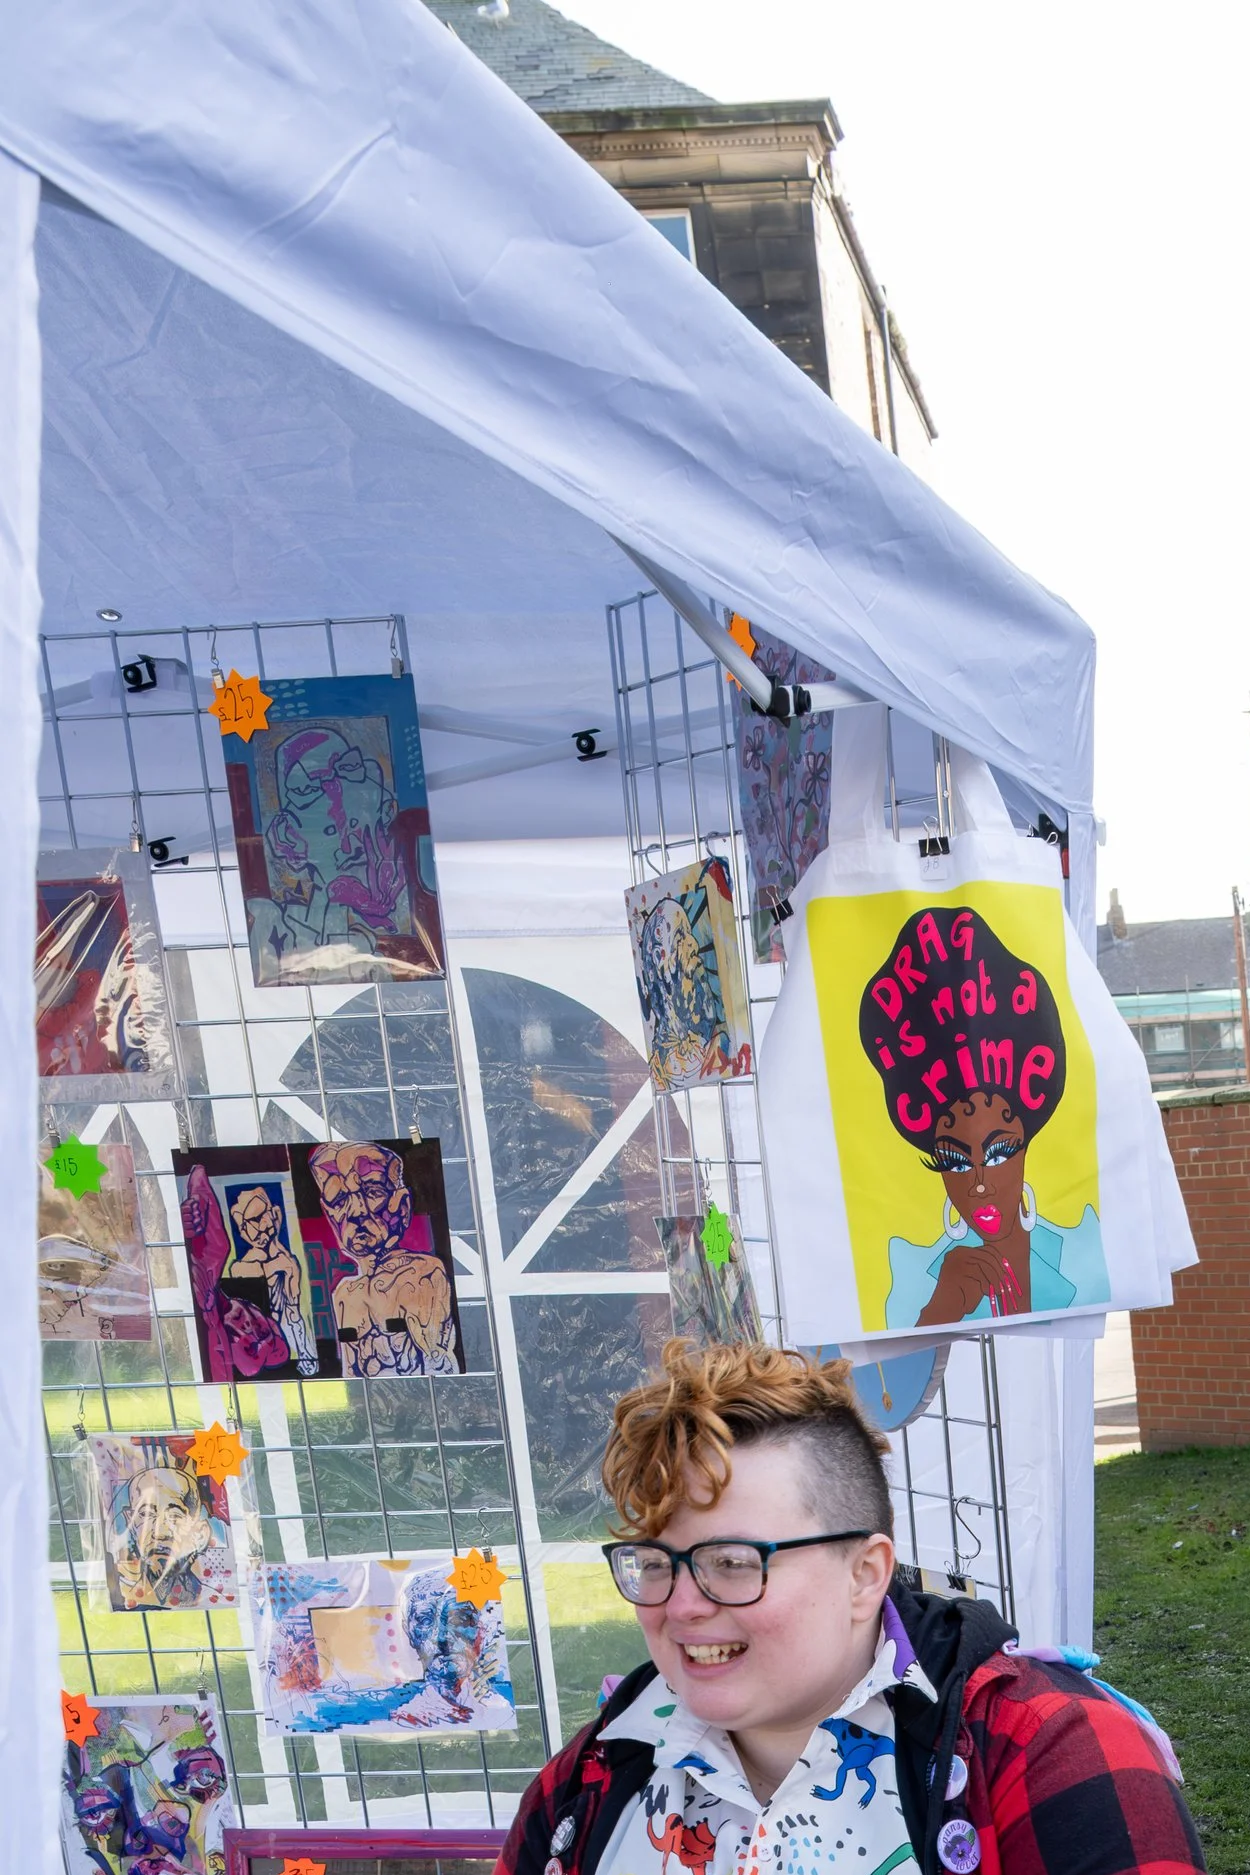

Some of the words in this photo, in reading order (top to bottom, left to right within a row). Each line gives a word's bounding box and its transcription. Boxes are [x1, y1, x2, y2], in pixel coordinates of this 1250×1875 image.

[218, 683, 254, 722] £25
[871, 911, 974, 1022] DRAG
[874, 1021, 927, 1069] is
[931, 958, 996, 1025] not
[1011, 969, 1037, 1015] a
[896, 1033, 1055, 1132] crime
[55, 1157, 78, 1176] £15
[197, 1435, 235, 1468] £25
[460, 1562, 493, 1591] £25
[941, 1821, 967, 1846] pansy
[956, 1851, 980, 1872] lover
